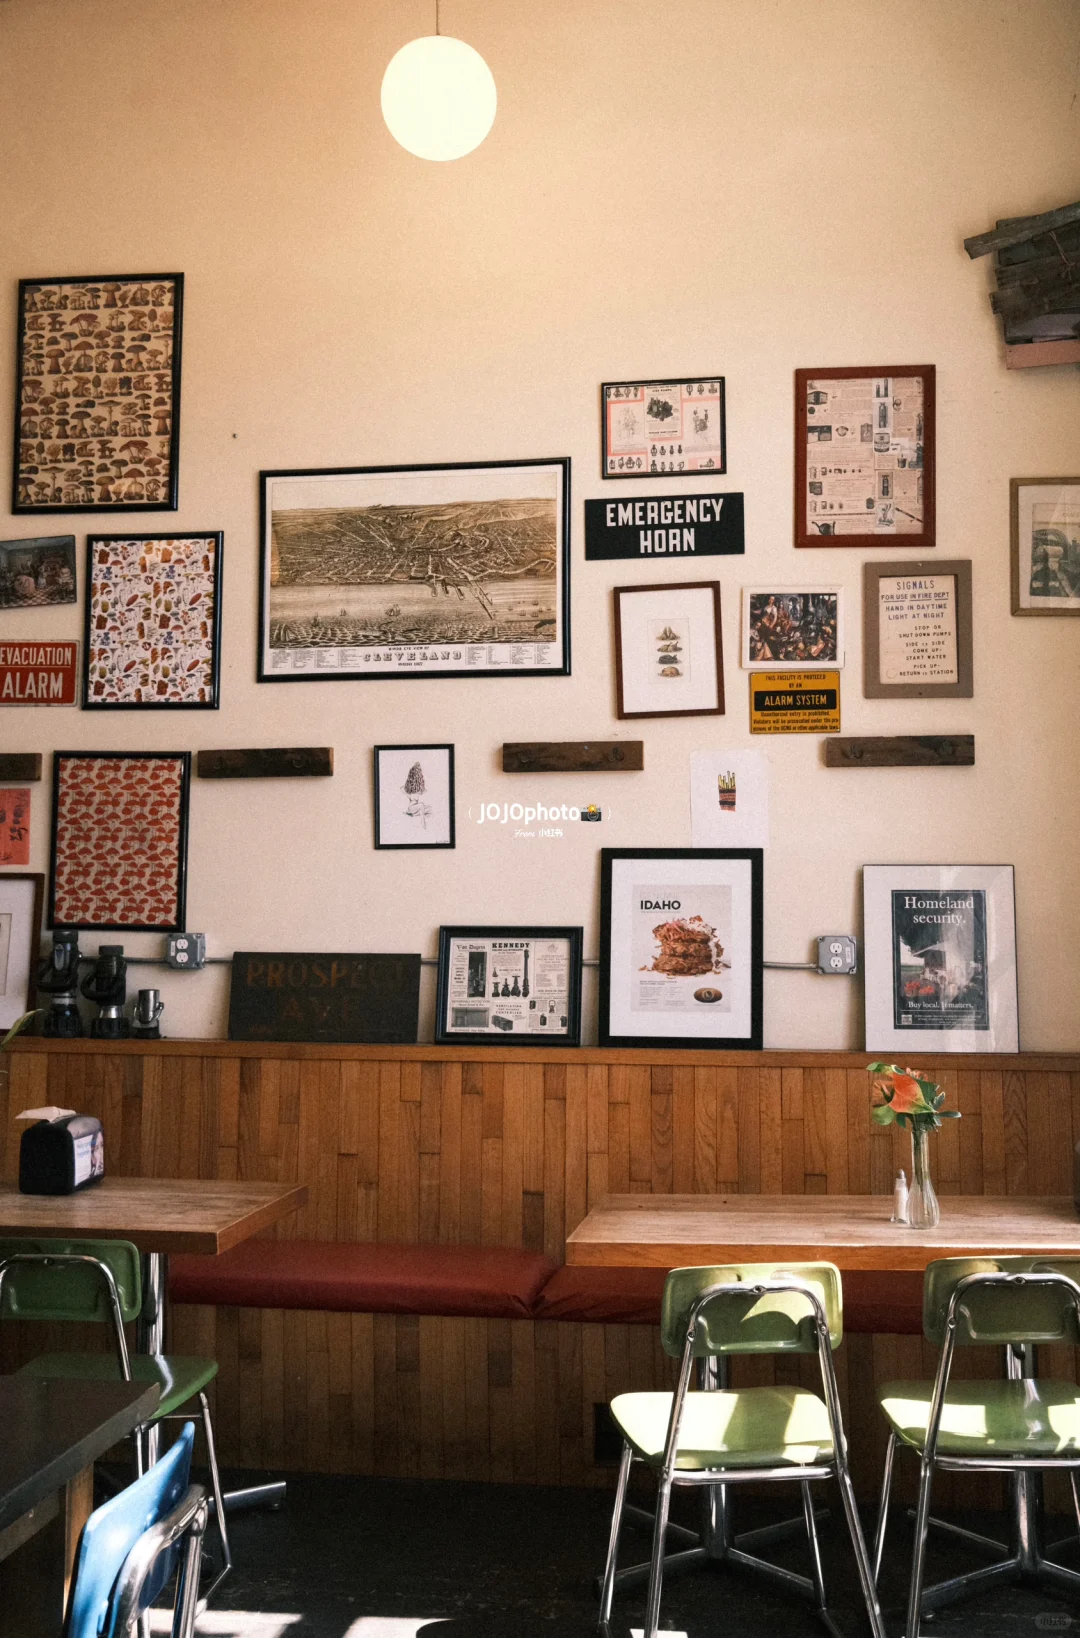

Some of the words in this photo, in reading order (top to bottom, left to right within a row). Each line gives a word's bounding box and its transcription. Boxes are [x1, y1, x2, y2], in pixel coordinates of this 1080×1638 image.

[606, 499, 723, 526] EMERGENCY
[640, 528, 695, 553] HORN
[896, 580, 935, 590] SIGNALS
[0, 647, 72, 665] EVACUATION
[363, 651, 462, 661] CLEVELAND
[2, 672, 63, 698] ALARM
[764, 695, 793, 706] ALARM
[796, 694, 827, 705] SYSTEM
[640, 900, 681, 910] IDAHO
[904, 897, 975, 909] Homeland
[913, 912, 966, 926] security.
[908, 1001, 922, 1009] Buy
